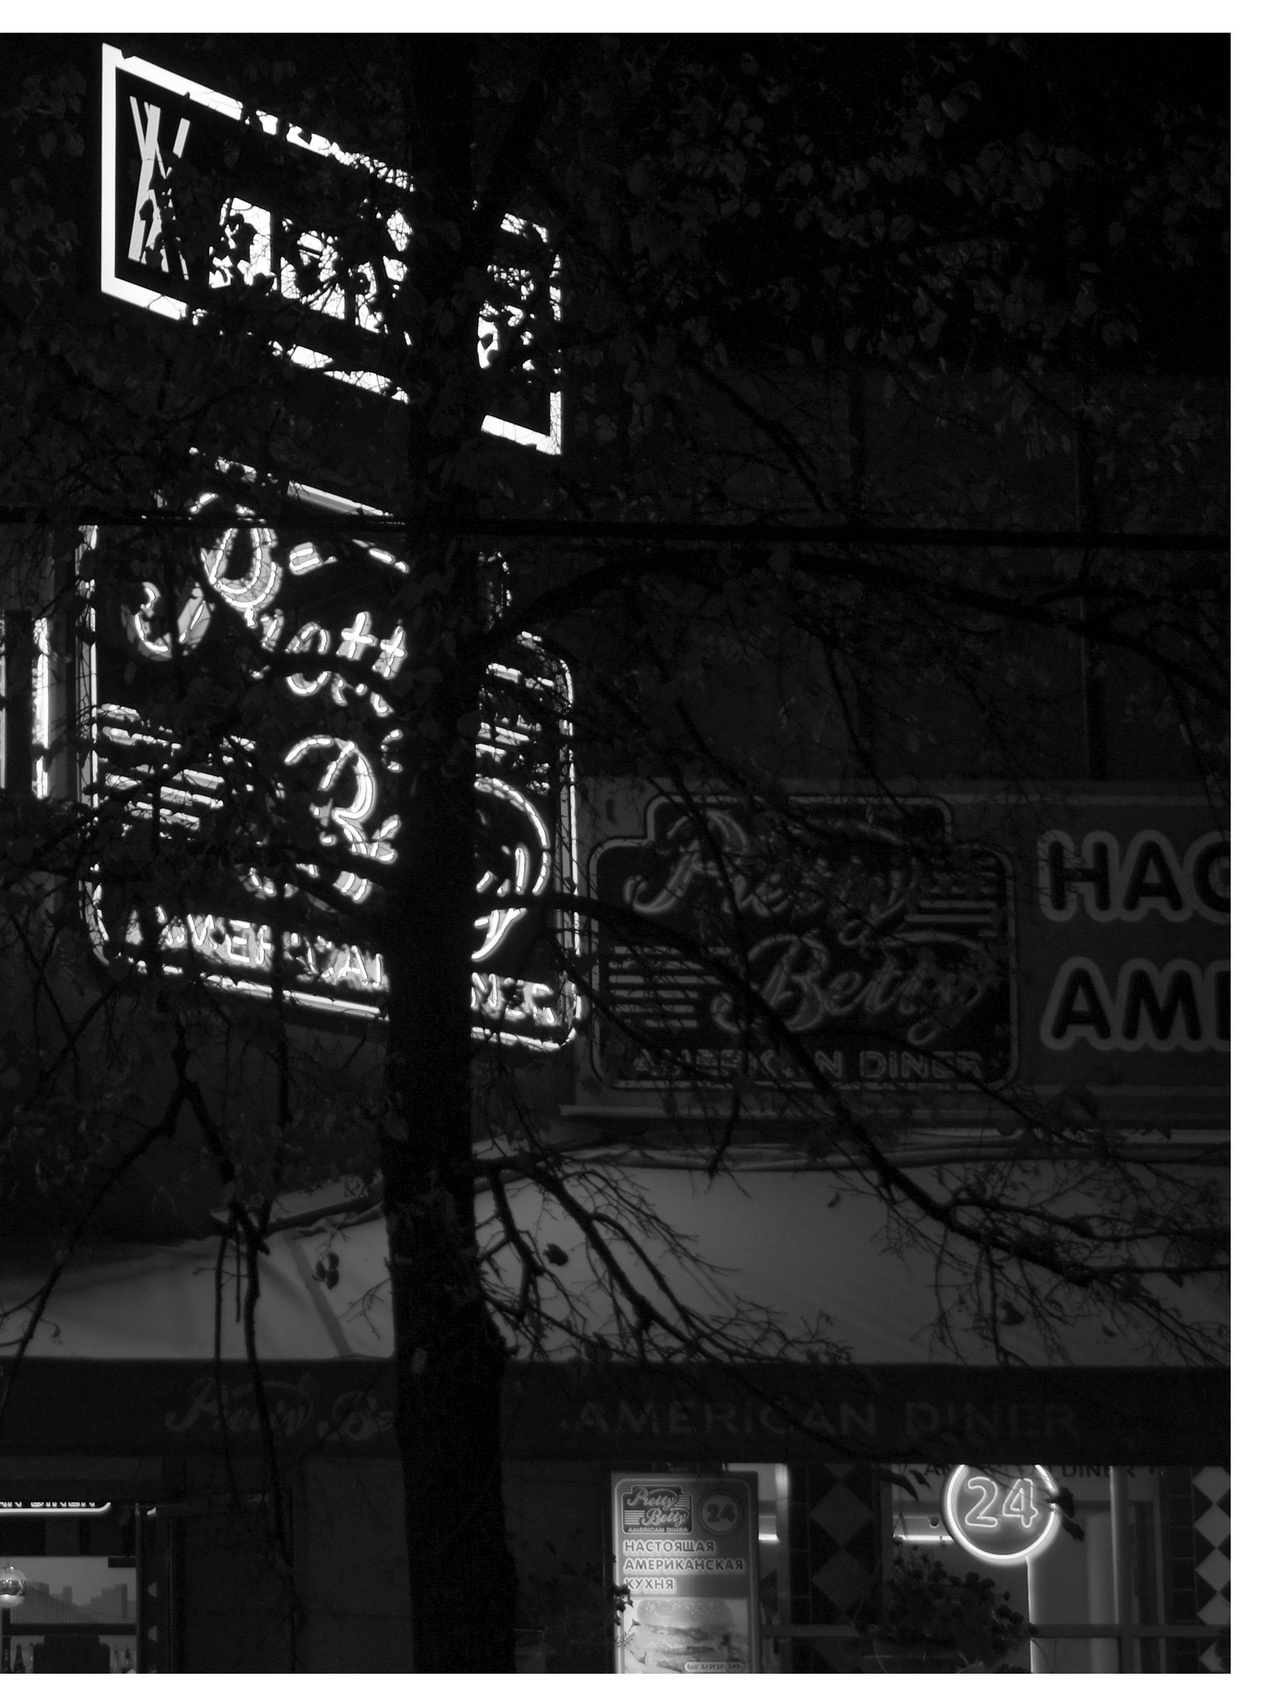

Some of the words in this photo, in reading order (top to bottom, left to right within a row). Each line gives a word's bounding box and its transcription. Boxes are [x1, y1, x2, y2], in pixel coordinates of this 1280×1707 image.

[859, 1050, 983, 1078] DINER
[626, 1486, 678, 1510] Pretty
[964, 1476, 1039, 1528] 24
[641, 1507, 690, 1527] Betty
[706, 1502, 736, 1523] 24
[624, 1540, 715, 1553] НАСТОЯЩАЯ
[624, 1559, 744, 1571] АМЕРИКАНСКАЯ
[625, 1578, 674, 1590] КУХНЯ
